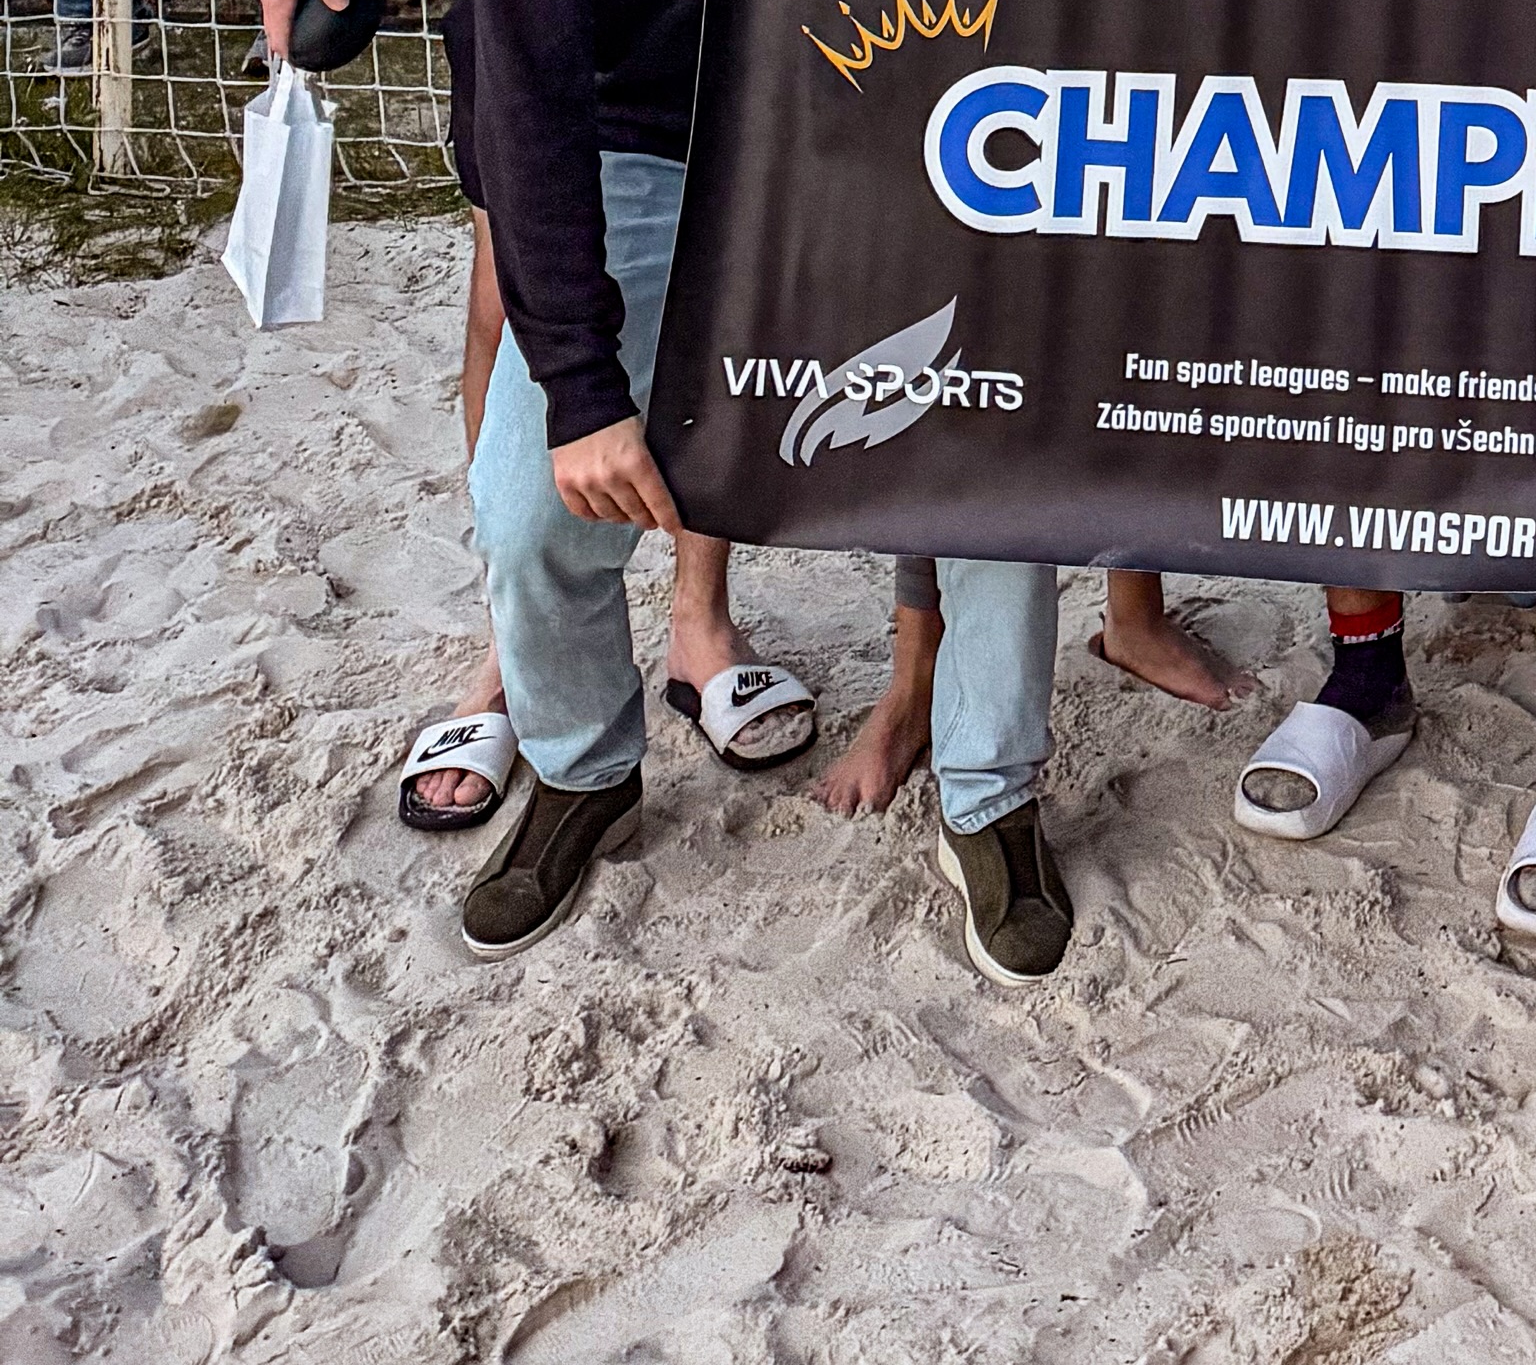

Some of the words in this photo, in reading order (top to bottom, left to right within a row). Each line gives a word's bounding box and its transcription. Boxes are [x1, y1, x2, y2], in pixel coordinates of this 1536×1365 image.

[723, 357, 828, 400] VIVA
[844, 362, 1024, 411] SPORTS
[1125, 353, 1170, 382] Fun
[1176, 357, 1242, 389] sport
[1250, 359, 1350, 394] leagues
[1381, 369, 1451, 399] make
[1096, 402, 1203, 436] Zábavné
[1210, 409, 1332, 445] sportovní
[1338, 413, 1386, 451] ligy
[1392, 422, 1434, 453] pro
[737, 671, 774, 690] NIKE
[434, 724, 484, 746] NIKE
